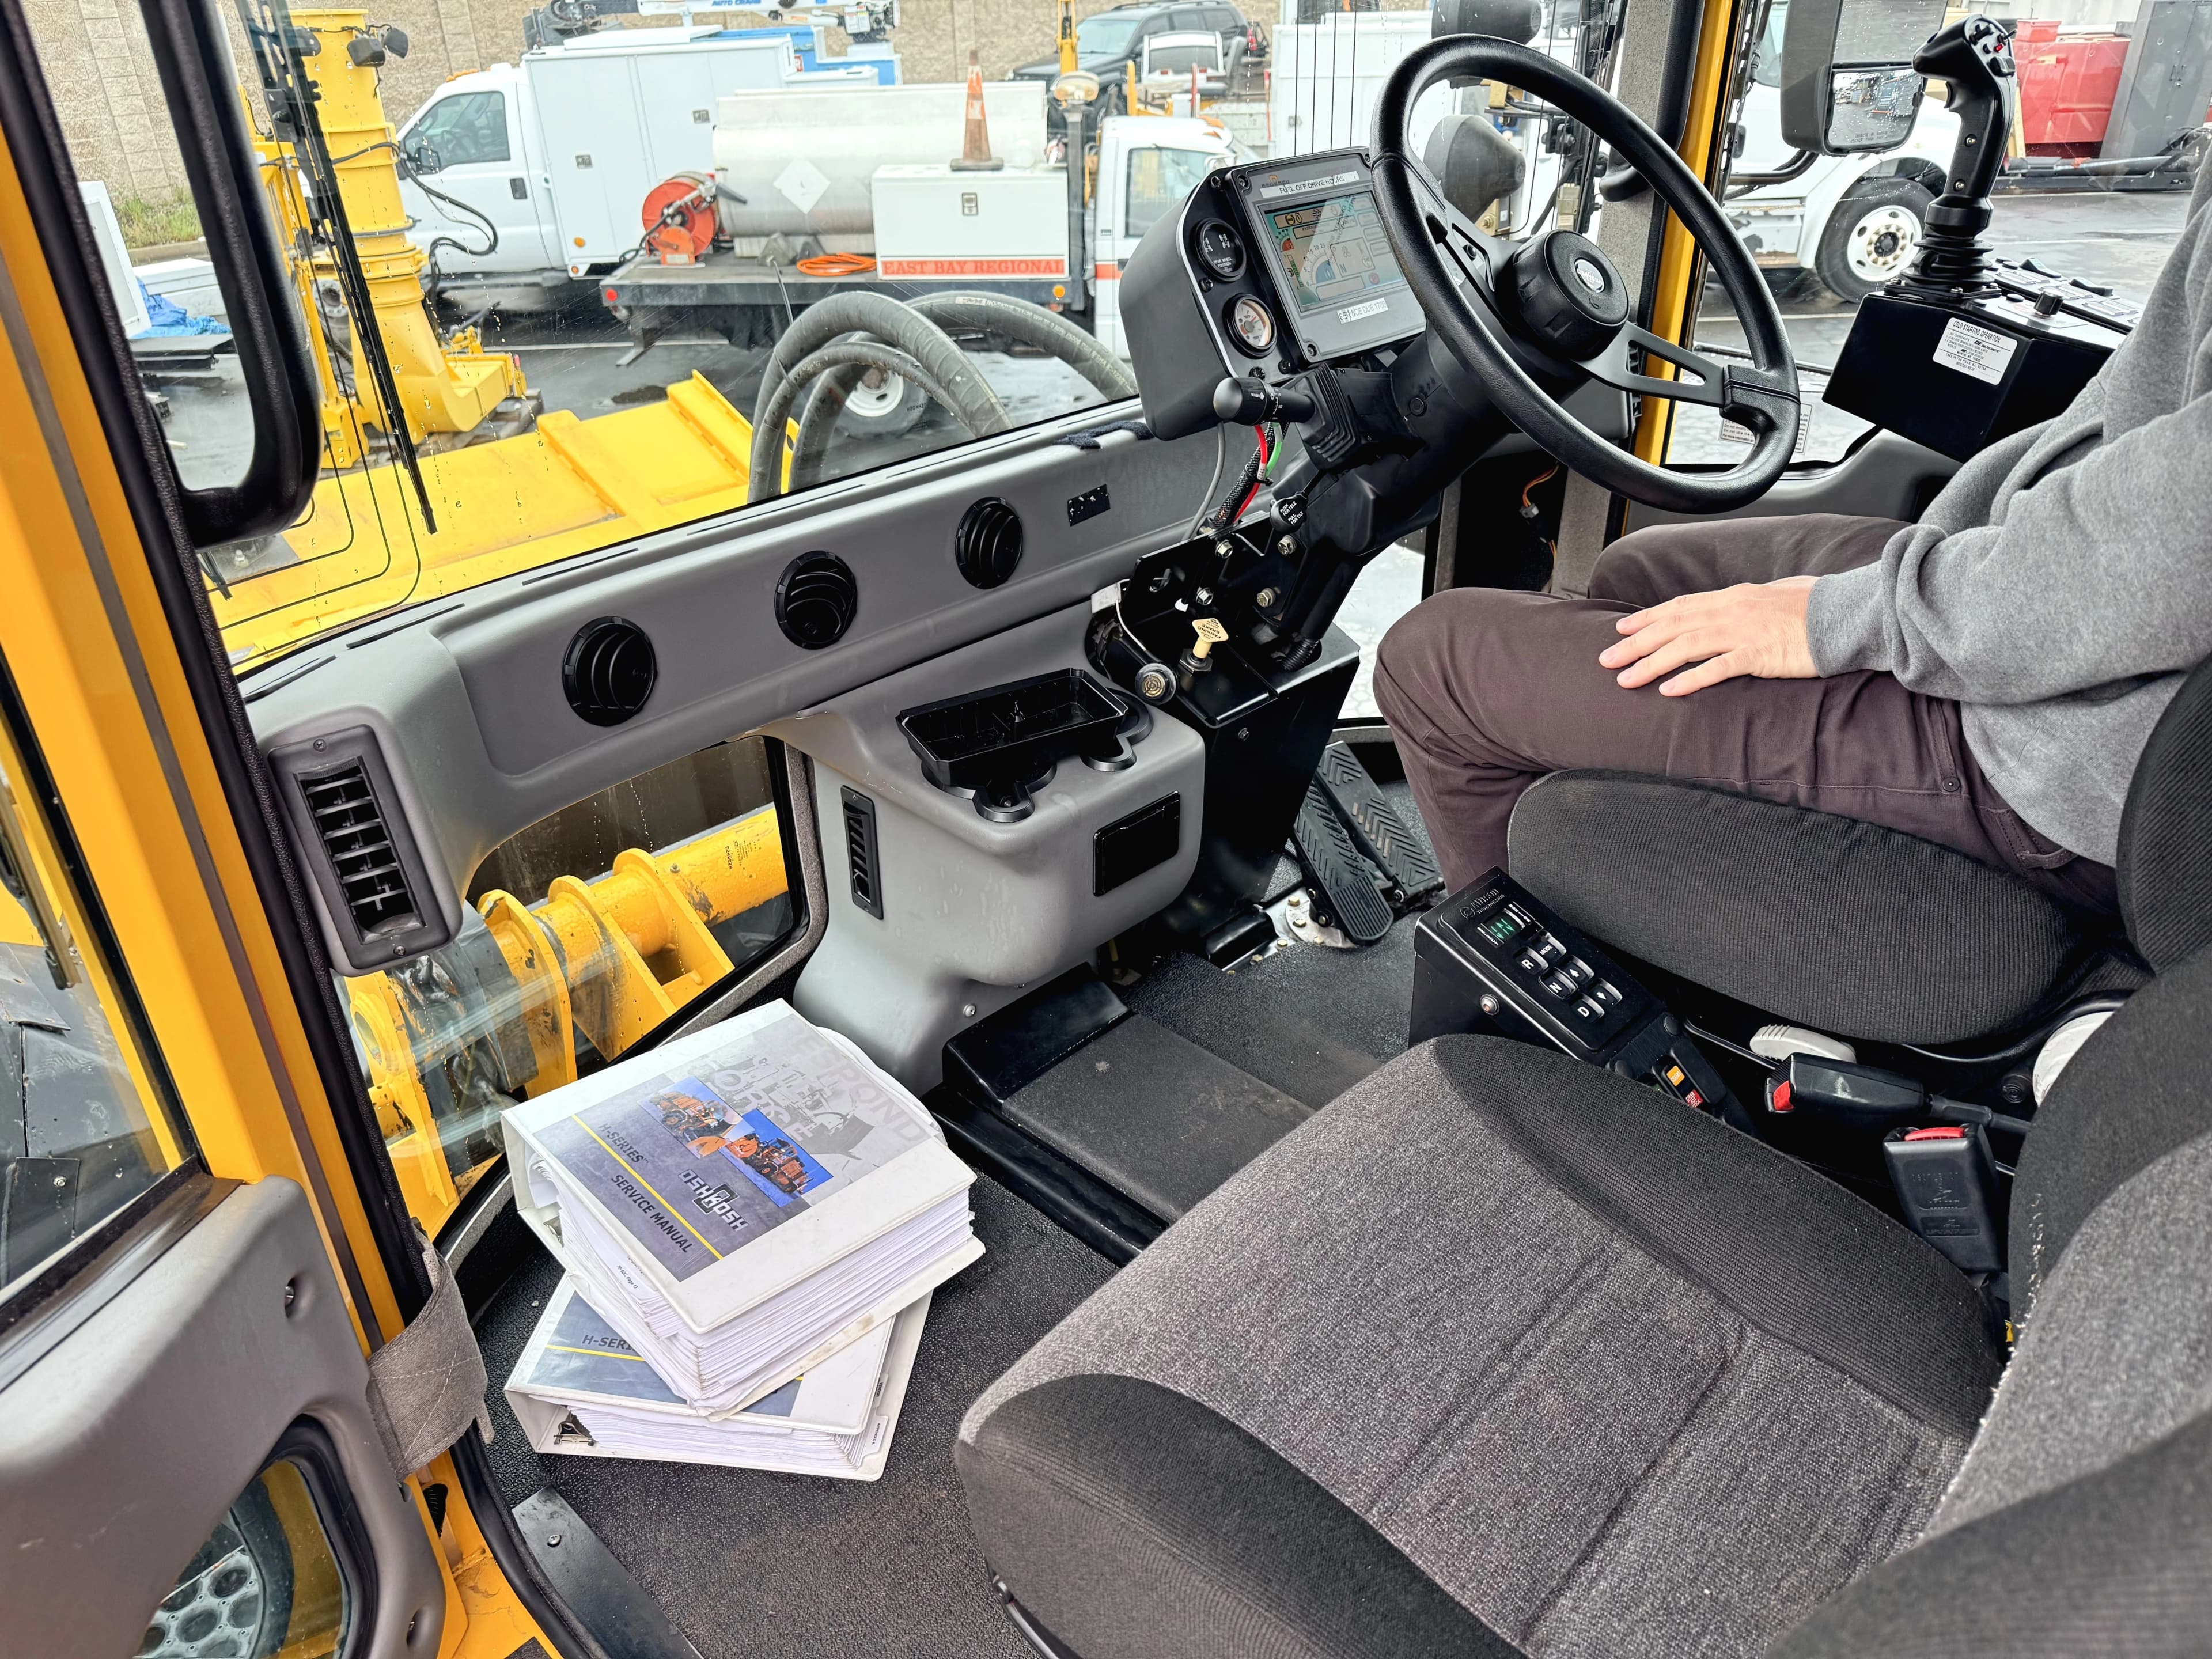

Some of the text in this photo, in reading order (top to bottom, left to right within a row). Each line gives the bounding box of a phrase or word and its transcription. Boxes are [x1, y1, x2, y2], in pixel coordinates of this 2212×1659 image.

[1279, 175, 1346, 194] FUEL OFF DRIVE HOURS
[884, 260, 1064, 275] EAST BAY REGIONAL
[1340, 263, 1347, 274] N
[1362, 304, 1374, 314] DUE
[1953, 320, 1963, 329] COLD
[1963, 324, 1981, 336] STARTING
[1980, 328, 2001, 343] OPERATION
[1280, 503, 1289, 513] PUSH
[1288, 501, 1297, 510] TELE
[1287, 513, 1297, 522] PULL
[1198, 626, 1221, 639] PARKING
[1202, 623, 1220, 634] BRAKE
[1539, 944, 1553, 955] MODE
[1521, 959, 1534, 969] R
[1549, 982, 1562, 993] N
[1577, 1006, 1590, 1017] D
[678, 1169, 749, 1232] OSHKOSH
[611, 1175, 694, 1253] SERVICE MANUAL
[582, 1335, 635, 1351] H-SERI
